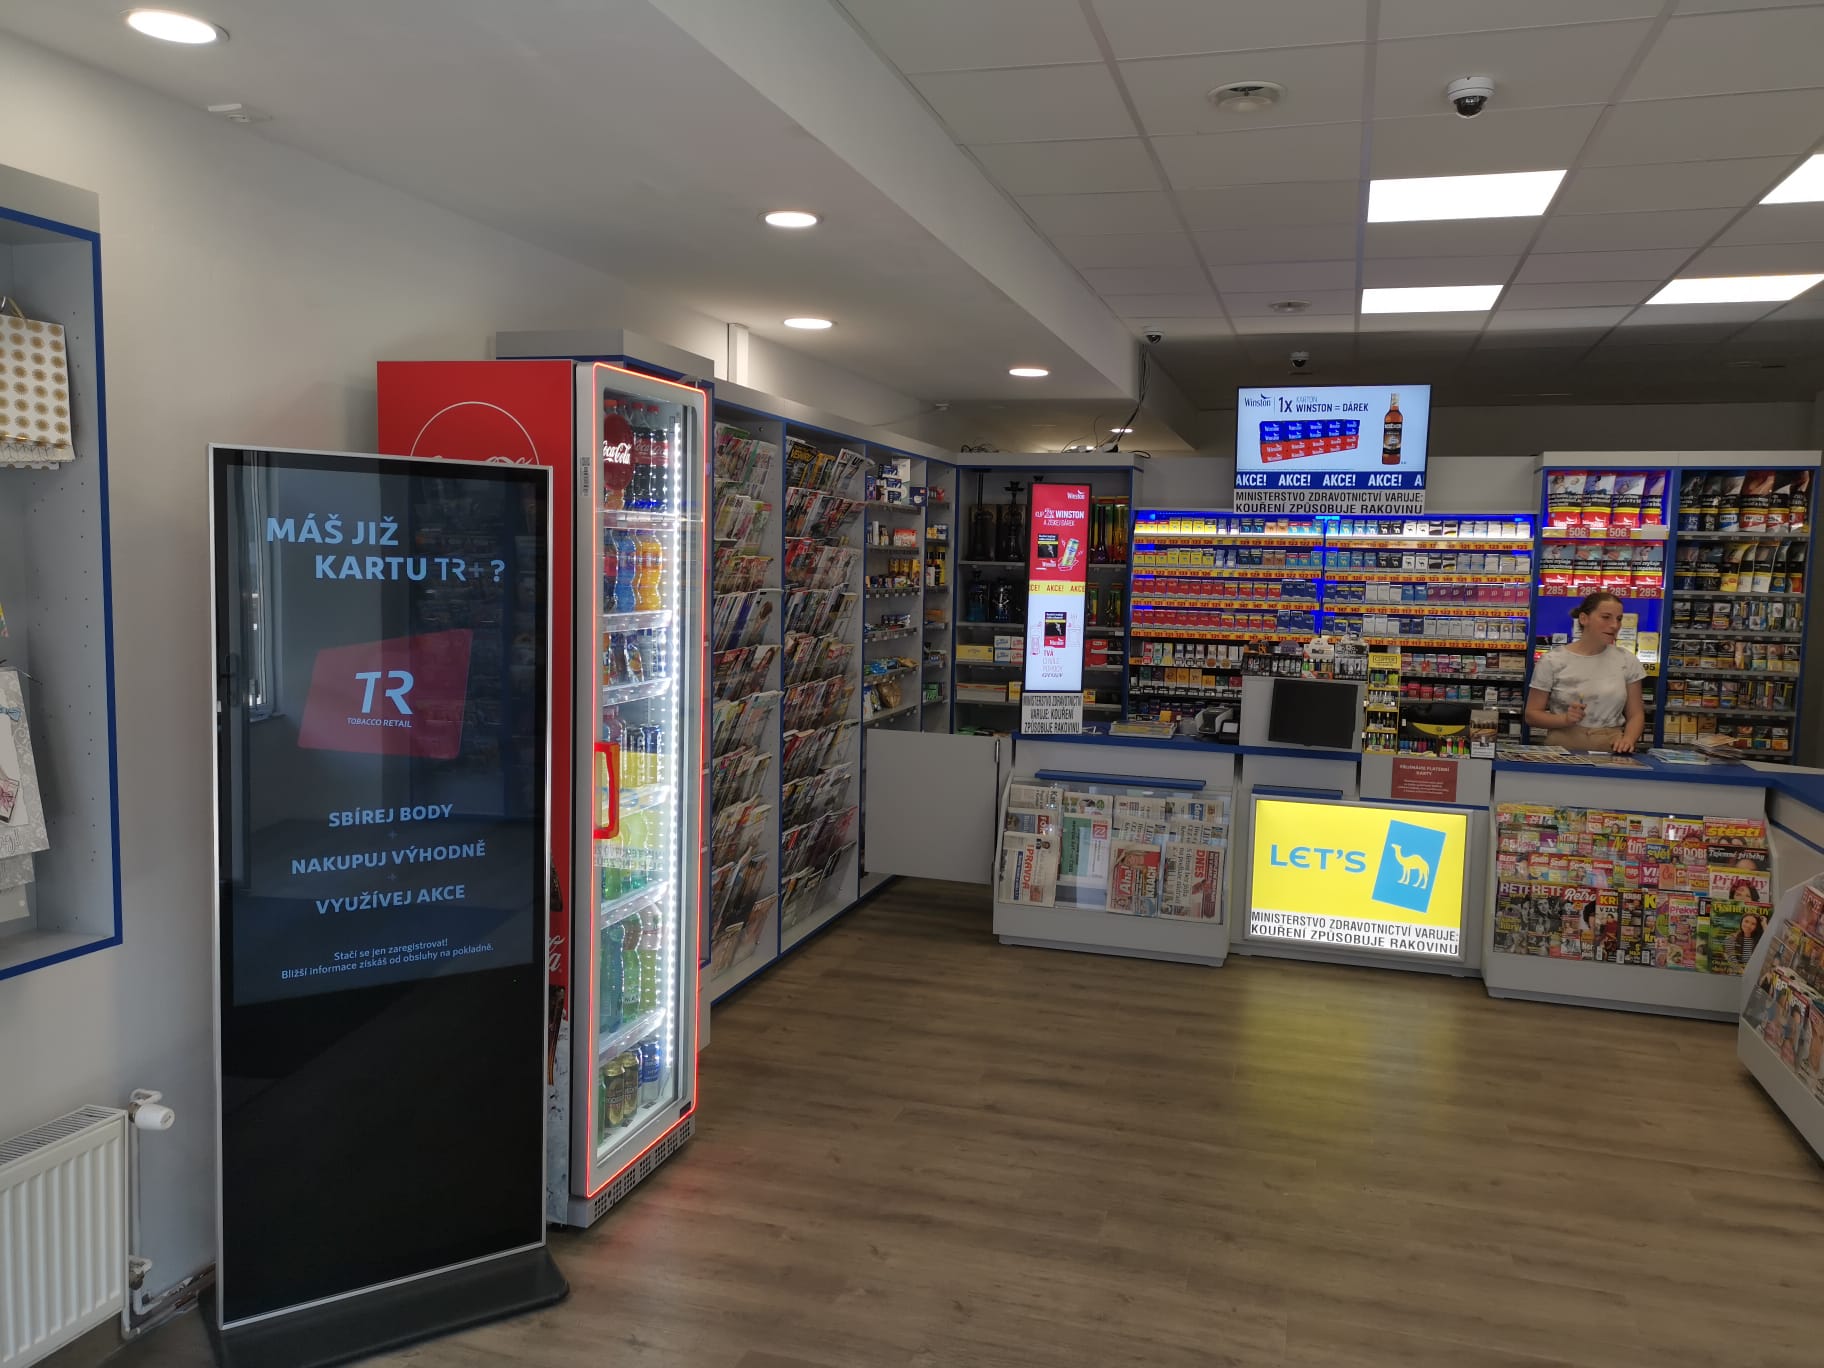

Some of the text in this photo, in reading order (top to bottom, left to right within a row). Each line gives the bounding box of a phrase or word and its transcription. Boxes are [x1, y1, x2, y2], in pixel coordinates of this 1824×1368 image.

[1244, 396, 1271, 407] Winston
[1296, 403, 1333, 413] WINSTON
[1342, 401, 1369, 412] DÁREK
[1278, 474, 1311, 486] AKCE!
[1323, 474, 1356, 486] AKCE!
[1368, 474, 1402, 487] AKCE!
[1236, 490, 1423, 502] MINISTERSTVO ZDRAVOTNICTVÍ VARUJE:
[1236, 501, 1423, 514] KOUŘENÍ ZPŮSOBUJE RAKOVINU
[1056, 510, 1084, 519] WINSTON
[266, 513, 399, 546] MÁŠ JIŽ
[1569, 527, 1627, 537] 506 506
[315, 555, 427, 582] KARTU
[1046, 584, 1064, 592] AKCE!
[1546, 586, 1657, 597] 285 285 285 285
[355, 670, 415, 715] TR
[1051, 708, 1074, 720] KOUŘENÍ
[347, 717, 412, 728] TOBACCO RETAIL
[1024, 721, 1079, 734] ZPŮSOBUJE RAKOVINU
[328, 804, 453, 828] SBÍREJ BODY
[291, 840, 486, 875] NAKUPUJ VÝHODNĚ
[1270, 844, 1366, 873] LET'S
[1738, 852, 1765, 861] příběhy
[1194, 849, 1205, 878] DNES
[316, 885, 465, 915] VYUŽÍVEJ AKCE
[1565, 888, 1597, 902] Retro
[1251, 911, 1459, 942] MINISTERSTVO ZDRAVOTNICTVÍ VARUJE:
[1251, 924, 1458, 955] KOUŘENÍ ZPŮSOBUJE RAKOVINU
[334, 951, 358, 961] Stačí
[371, 947, 386, 958] jen
[388, 938, 448, 954] zaregistrovat!
[281, 943, 494, 980] Bližší informace získáš od obsluhy na pokladně.
